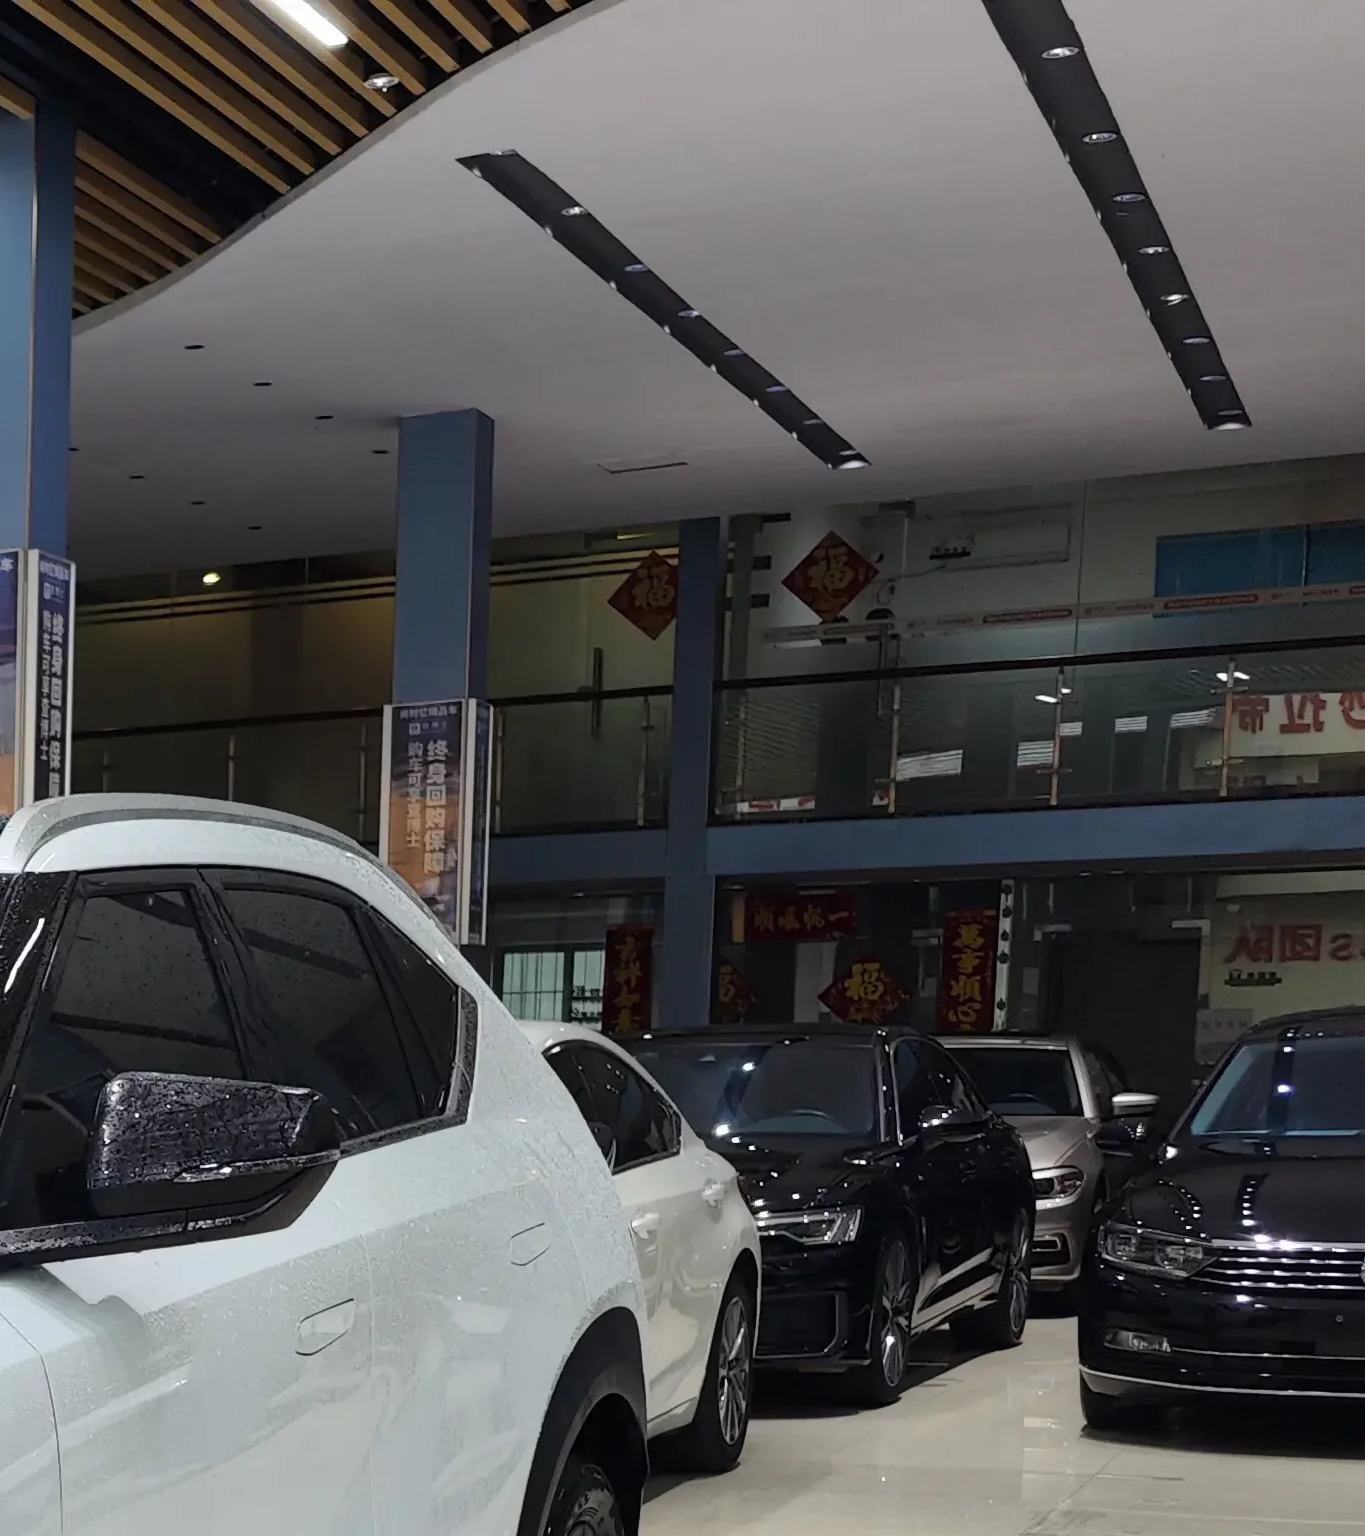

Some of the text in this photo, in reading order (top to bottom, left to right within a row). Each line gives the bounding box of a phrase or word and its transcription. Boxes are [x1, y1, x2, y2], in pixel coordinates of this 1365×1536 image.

[631, 565, 676, 611] 福
[805, 546, 855, 595] 福
[423, 739, 449, 874] 终身回购保障
[844, 960, 886, 1001] 福
